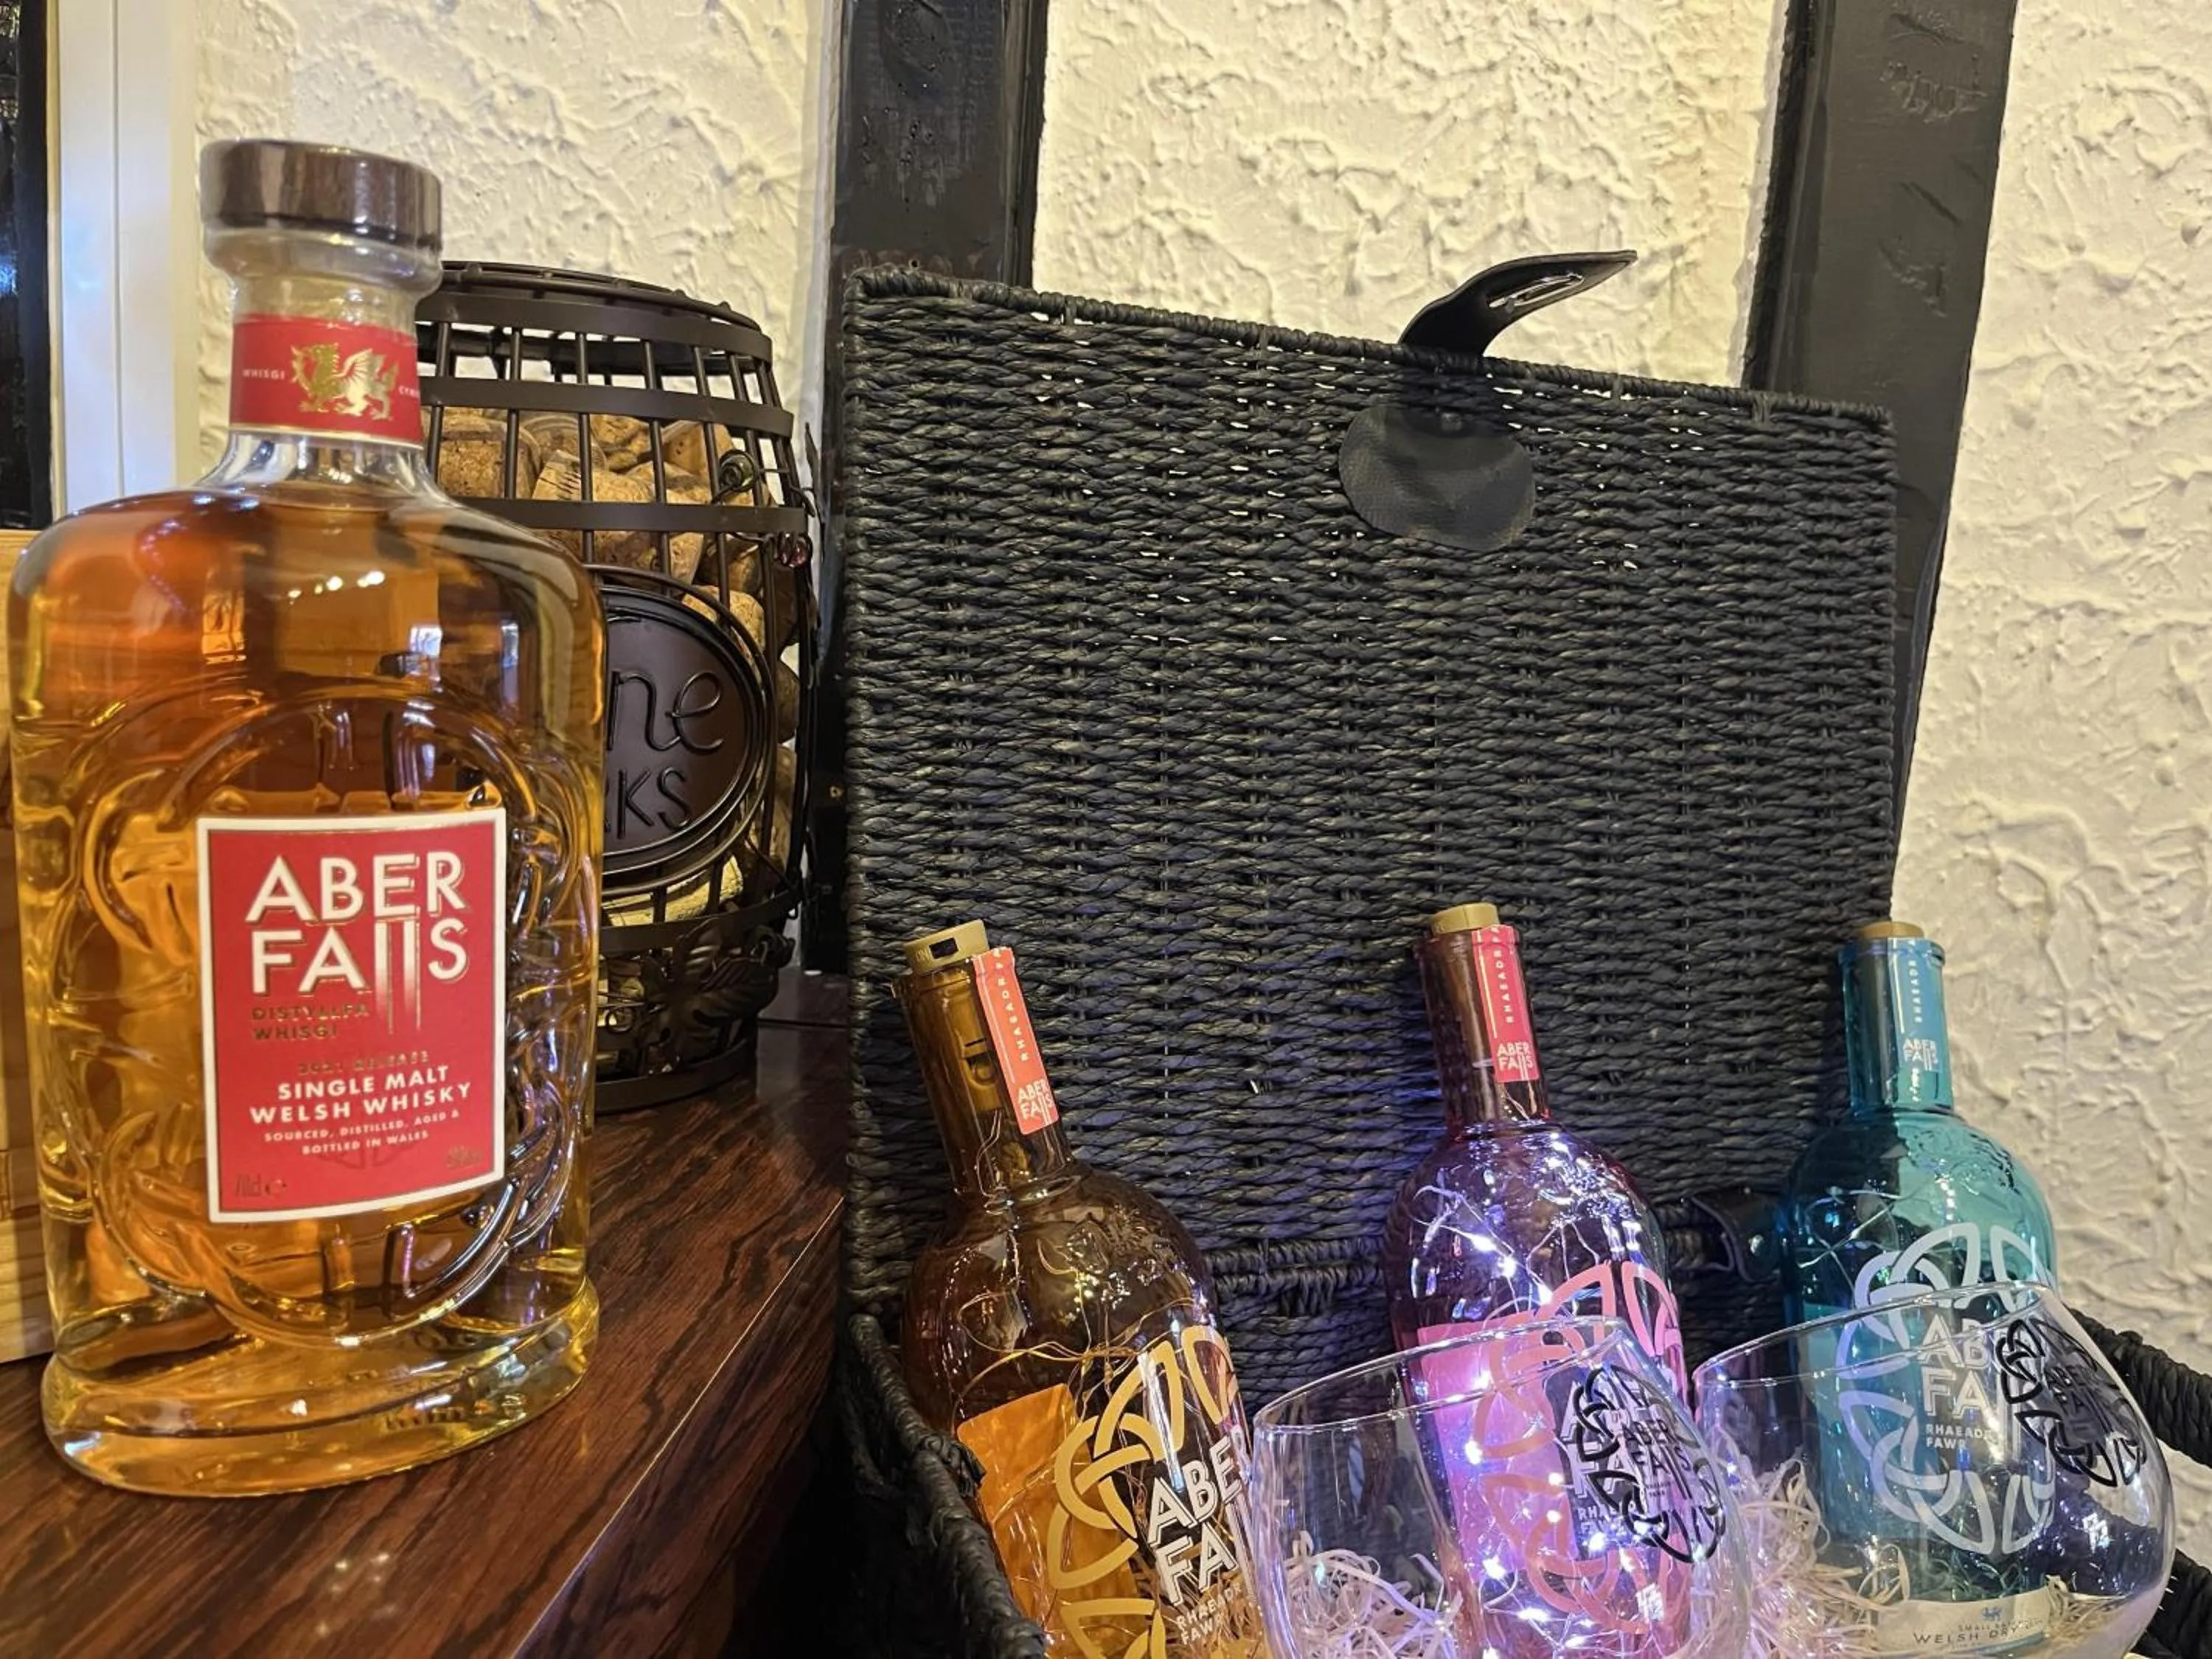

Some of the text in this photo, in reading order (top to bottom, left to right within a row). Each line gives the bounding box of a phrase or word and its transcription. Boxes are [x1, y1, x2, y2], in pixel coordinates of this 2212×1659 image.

[245, 851, 467, 924] ABER
[1498, 1041, 1531, 1056] ABER
[278, 1065, 450, 1101] SINGLE MALT
[1017, 1079, 1051, 1105] ABER
[249, 1082, 472, 1124] WELSH WHISKY
[302, 1130, 429, 1155] BOTTLED IN WALES
[1913, 1632, 1979, 1645] WELSH
[1989, 1627, 2018, 1639] DRY
